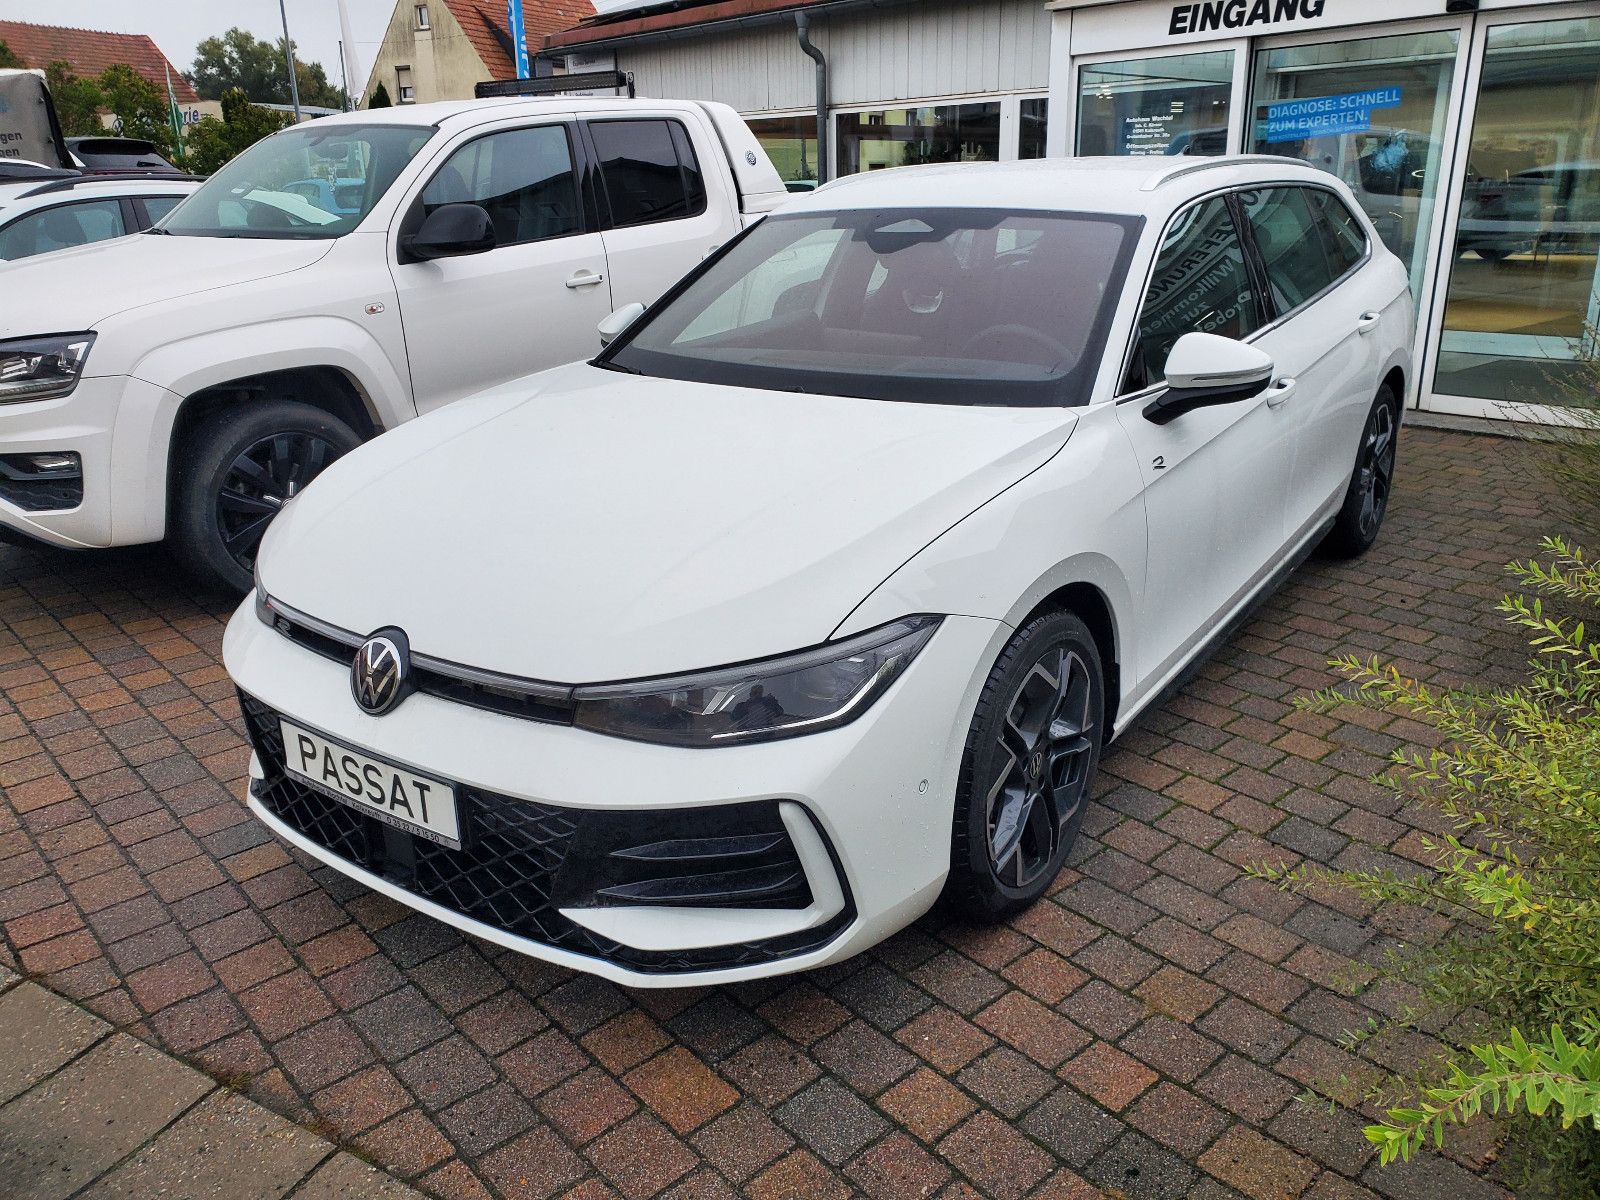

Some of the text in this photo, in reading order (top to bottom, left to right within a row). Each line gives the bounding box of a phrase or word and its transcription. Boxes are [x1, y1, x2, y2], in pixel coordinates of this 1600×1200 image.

[1168, 0, 1326, 36] EINGANG
[1269, 90, 1400, 119] DIAGNOSE: SCHNELL
[1269, 120, 1296, 133] ZUM
[1299, 110, 1369, 129] EXPERTEN.
[297, 733, 431, 823] PASSAT
